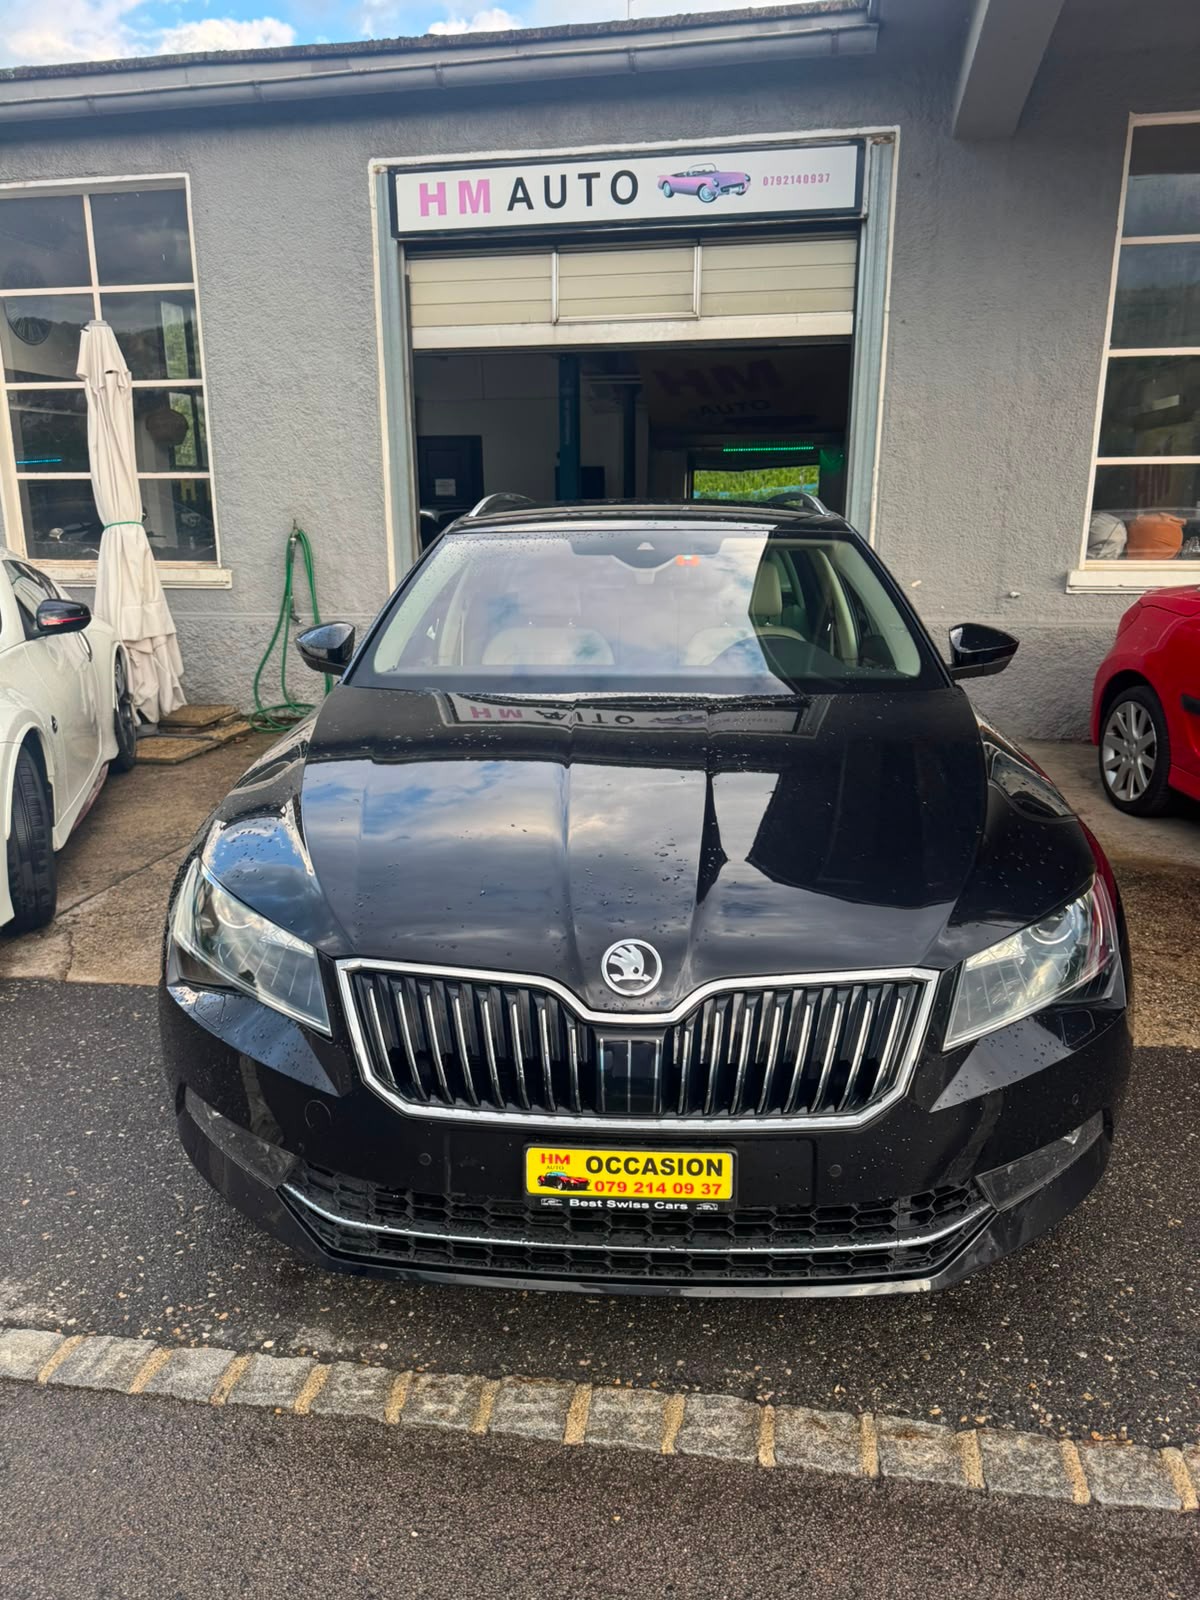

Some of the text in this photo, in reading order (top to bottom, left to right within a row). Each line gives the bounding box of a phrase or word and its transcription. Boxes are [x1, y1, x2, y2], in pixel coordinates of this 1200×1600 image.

[762, 173, 831, 187] 0792140937
[419, 170, 639, 217] HM AUTO
[541, 1153, 570, 1165] HM
[585, 1156, 723, 1177] OCCASION
[594, 1181, 722, 1195] 079 214 09 37
[569, 1198, 688, 1210] Best Swiss Cars
